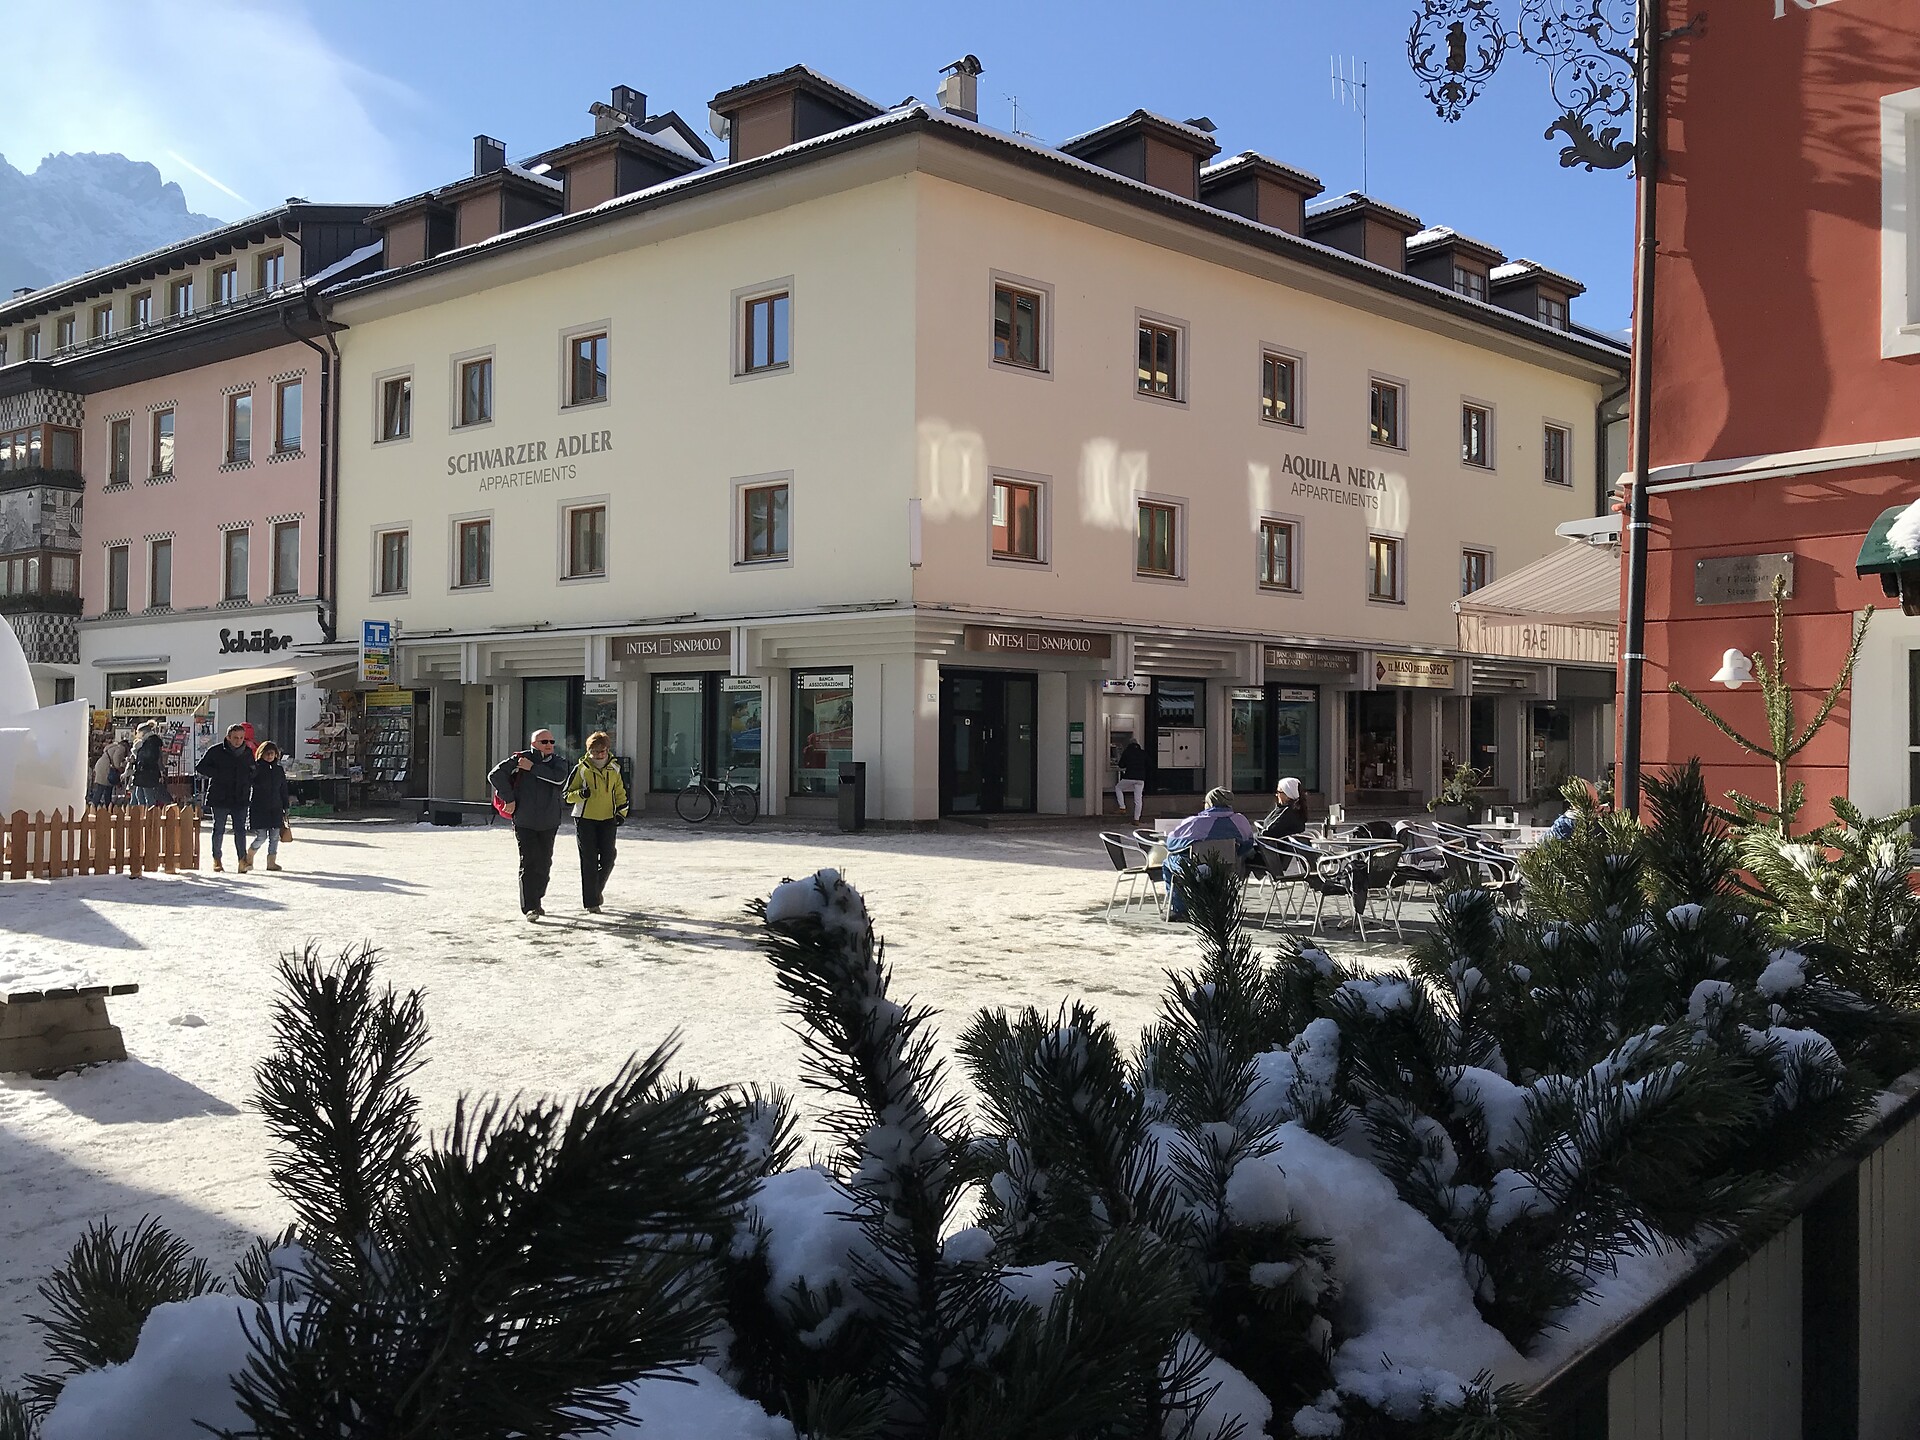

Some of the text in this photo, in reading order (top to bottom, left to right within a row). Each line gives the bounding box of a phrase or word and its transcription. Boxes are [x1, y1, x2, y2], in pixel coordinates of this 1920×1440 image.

[447, 430, 613, 476] SCHWARZER ADLER
[479, 464, 577, 492] APPARTEMENTS
[1281, 453, 1387, 492] AQUILA NERA
[1290, 482, 1379, 510] APPARTEMENTS
[219, 628, 293, 654] Schäfer
[626, 637, 721, 654] INTESA SANPAOLO
[988, 633, 1091, 651] INTESA SANPAOLO
[1394, 661, 1413, 673] MASO
[1413, 664, 1429, 674] DELLO
[1429, 663, 1449, 675] SPECK
[114, 696, 158, 708] TABACCHI
